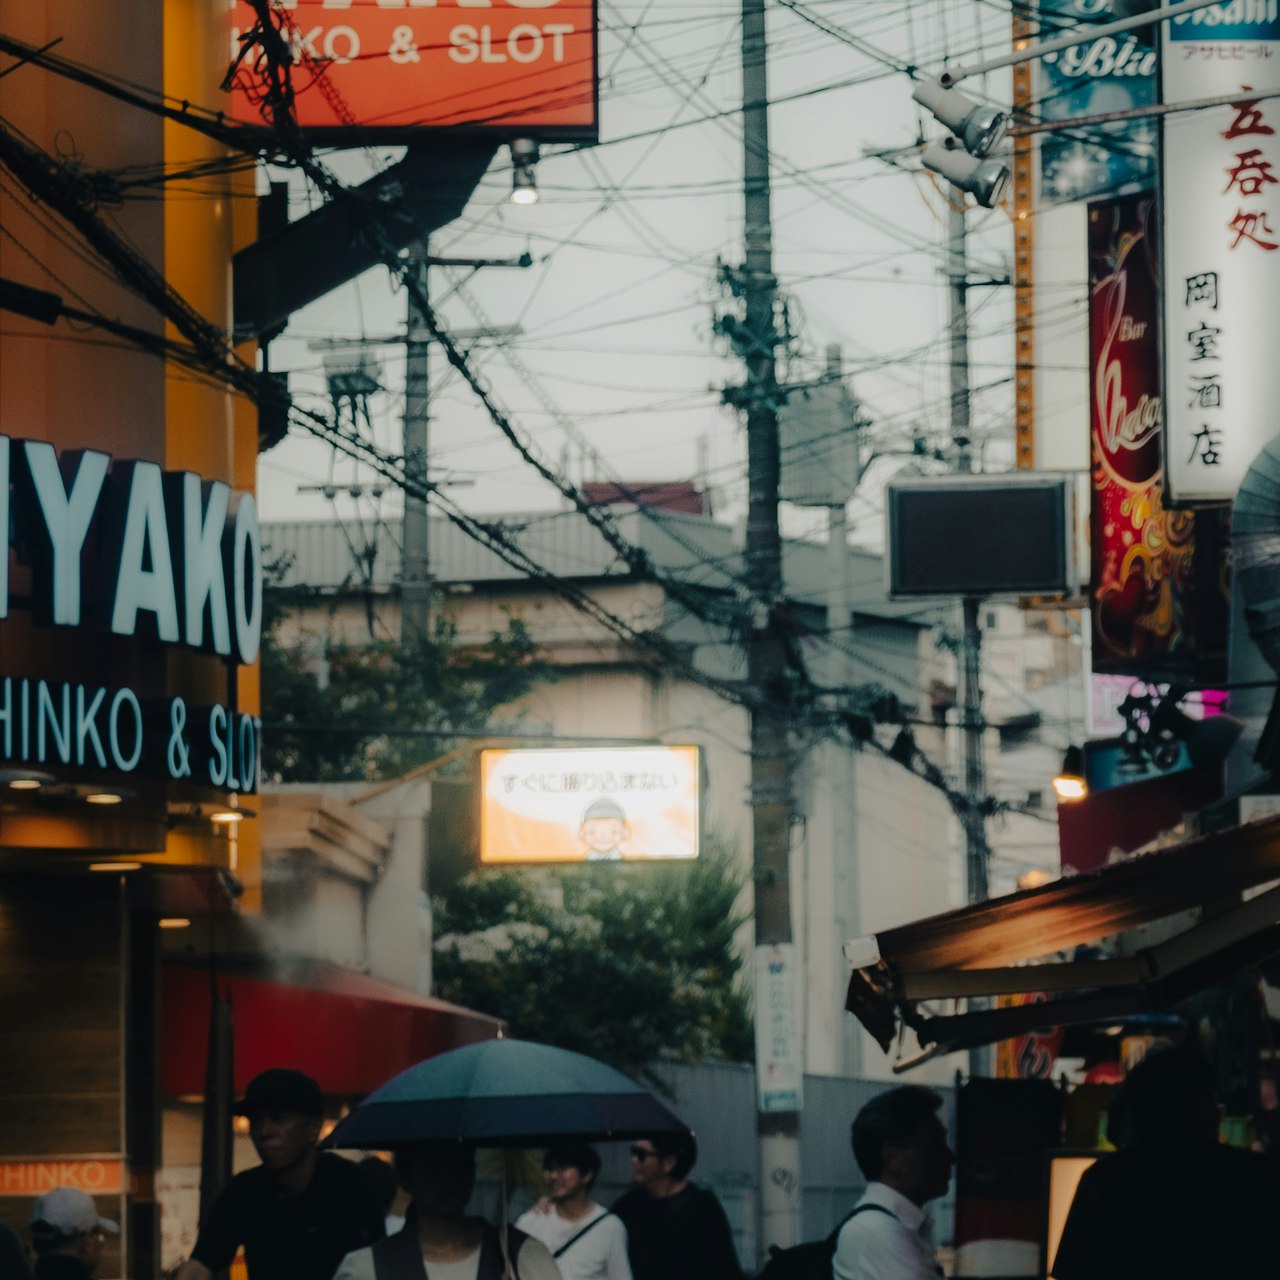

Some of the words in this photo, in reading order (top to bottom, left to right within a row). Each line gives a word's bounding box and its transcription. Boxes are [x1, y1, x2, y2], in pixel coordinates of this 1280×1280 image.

[388, 24, 421, 64] &
[447, 22, 575, 64] SLOT
[1183, 44, 1275, 61] アサヒビール
[1219, 84, 1280, 252] 立呑処
[1184, 271, 1222, 465] 岡室酒店
[167, 695, 191, 780] &
